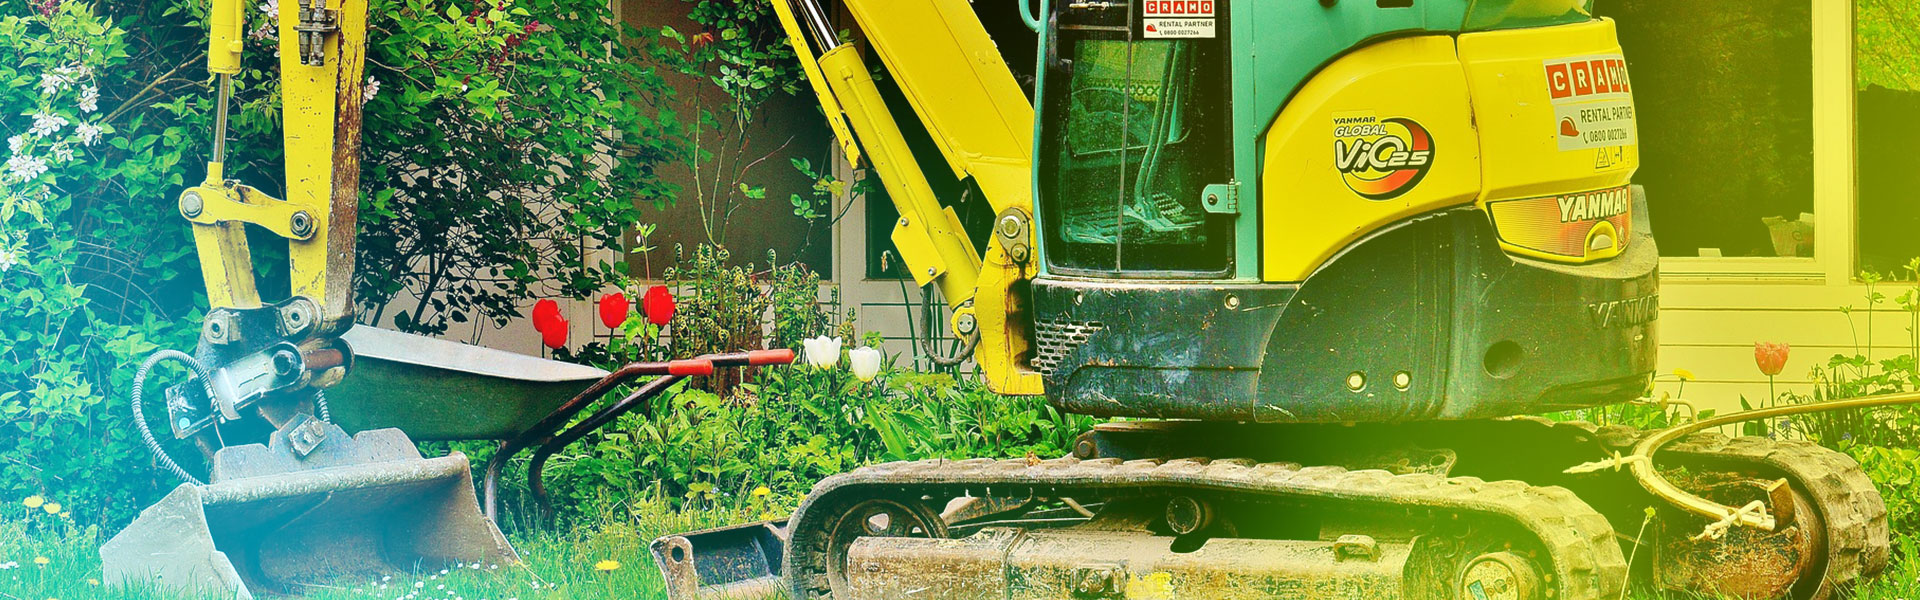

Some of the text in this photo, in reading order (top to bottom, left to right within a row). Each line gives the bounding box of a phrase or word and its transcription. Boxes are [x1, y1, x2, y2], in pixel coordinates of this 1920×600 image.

[1147, 2, 1211, 12] CRAMO
[1580, 107, 1611, 123] RENTAL
[1334, 125, 1387, 137] GLOBAL
[1589, 129, 1606, 142] 0800
[1557, 188, 1628, 222] YANMAR
